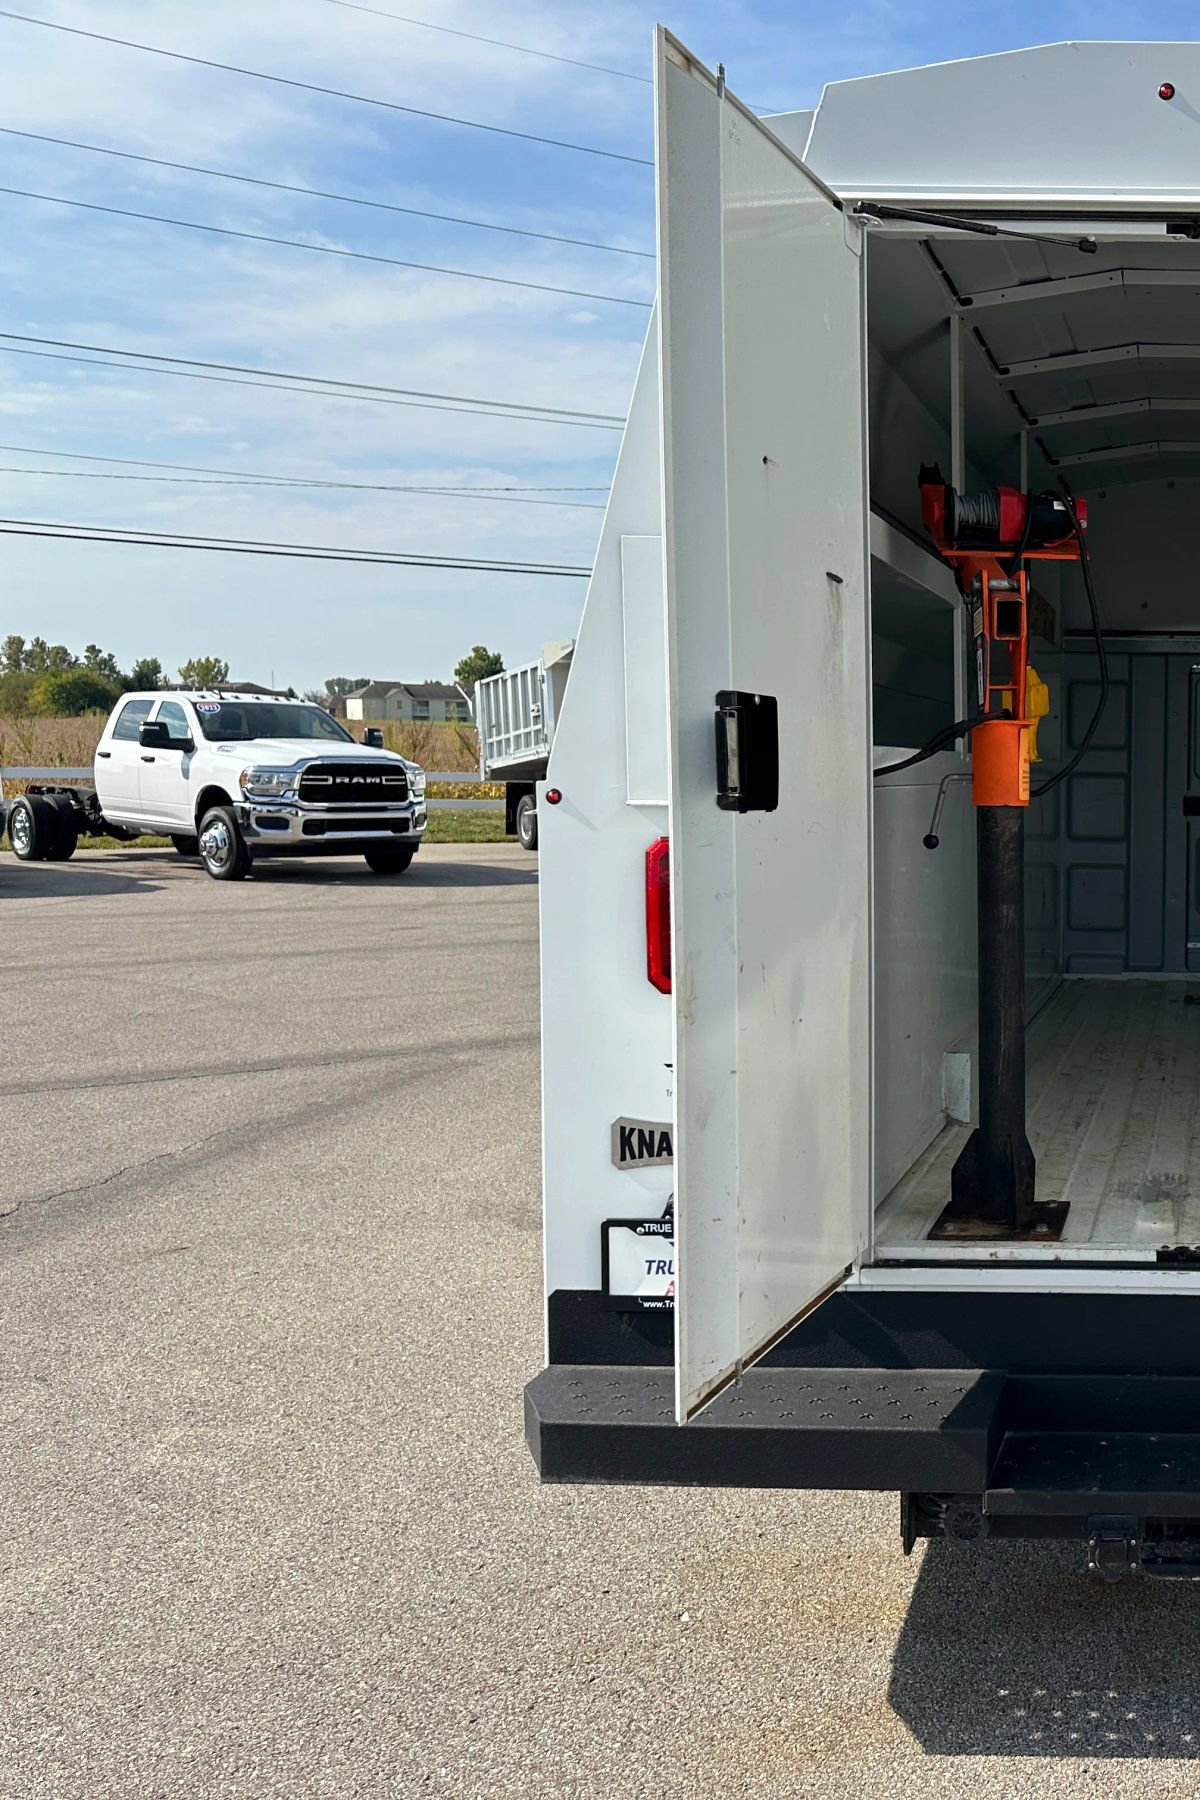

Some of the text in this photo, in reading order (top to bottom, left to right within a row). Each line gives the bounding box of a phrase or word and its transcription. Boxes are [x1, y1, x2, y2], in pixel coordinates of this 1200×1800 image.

[335, 776, 381, 784] RAM
[619, 1125, 674, 1162] KNA
[643, 1223, 673, 1233] TRUE
